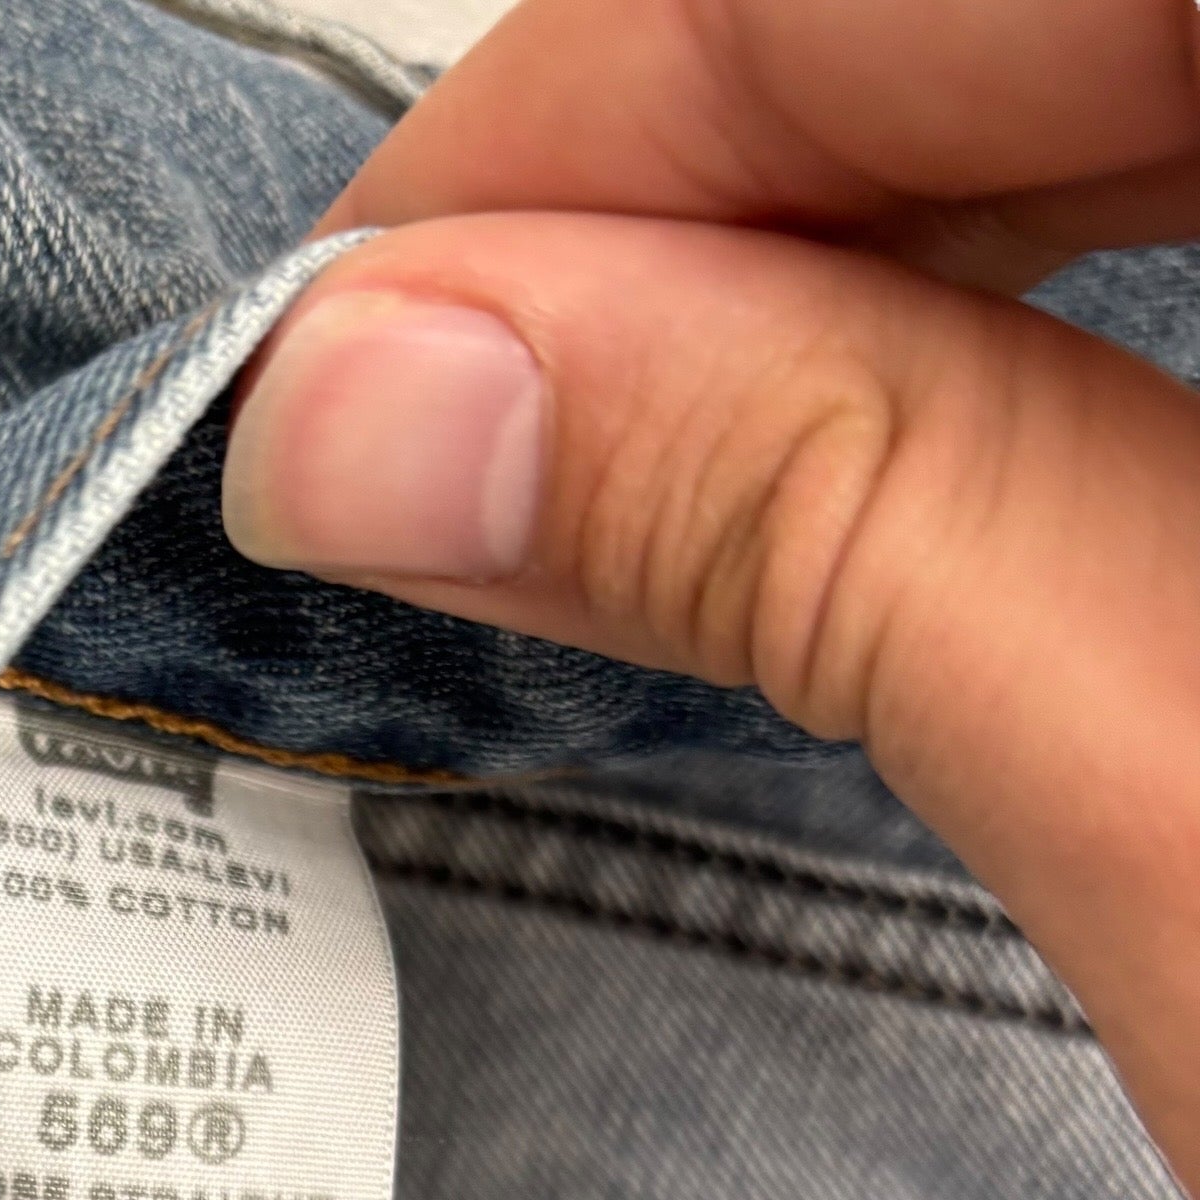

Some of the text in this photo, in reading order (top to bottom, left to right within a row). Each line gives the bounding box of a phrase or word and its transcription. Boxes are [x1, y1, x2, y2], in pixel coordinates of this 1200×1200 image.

[35, 787, 228, 854] levi.com
[99, 835, 291, 897] USA-LEVI
[108, 886, 291, 935] COTTON
[26, 983, 246, 1045] MADE IN
